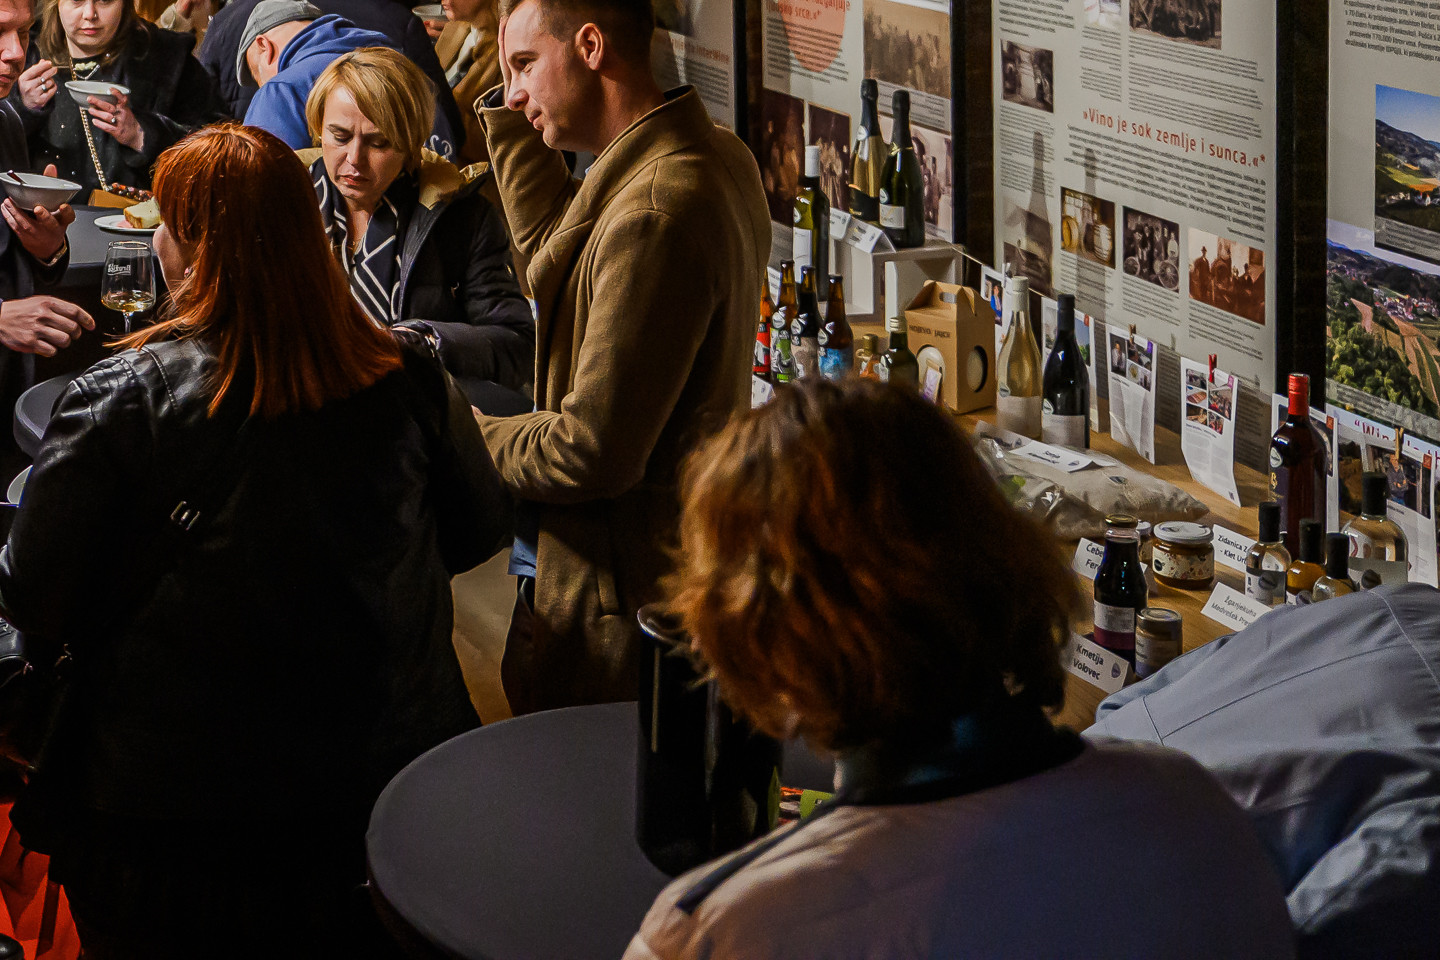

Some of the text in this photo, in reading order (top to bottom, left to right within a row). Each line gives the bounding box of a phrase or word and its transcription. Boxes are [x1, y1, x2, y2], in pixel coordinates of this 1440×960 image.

[1082, 107, 1113, 129] »Vino
[1117, 115, 1127, 134] je
[1131, 121, 1151, 139] sok
[1155, 129, 1197, 153] zemlje
[1200, 137, 1205, 153] i
[1086, 543, 1104, 558] Čebe
[1217, 534, 1242, 552] Zidanica
[1223, 549, 1236, 560] Klet
[1085, 558, 1099, 570] Fer
[1239, 616, 1251, 626] Pre
[1076, 643, 1104, 666] Kmetija
[1073, 658, 1100, 680] Volovec
